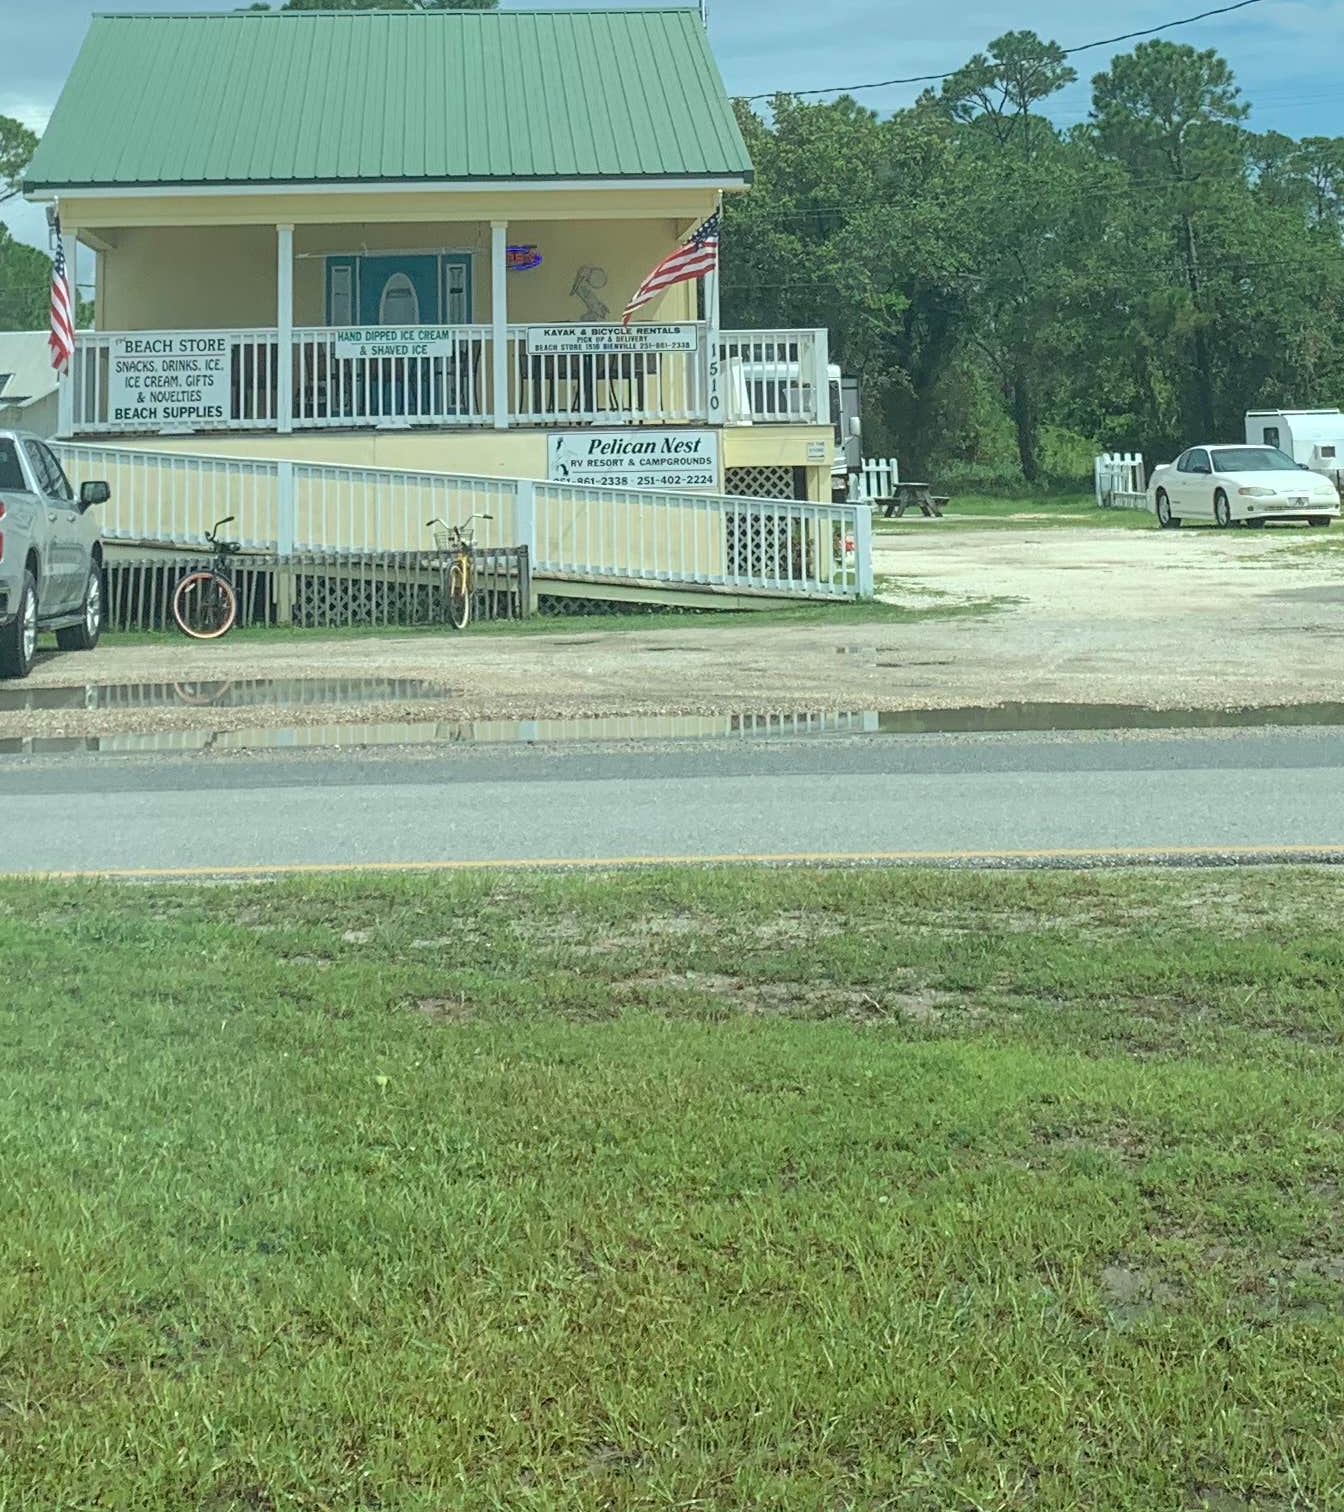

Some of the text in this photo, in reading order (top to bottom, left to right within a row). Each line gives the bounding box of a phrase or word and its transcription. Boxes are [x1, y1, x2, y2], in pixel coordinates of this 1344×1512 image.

[337, 330, 449, 342] HAND DIPPED ICE CREAM
[580, 328, 587, 336] &
[591, 327, 632, 335] BICYCLE
[125, 339, 226, 353] BEACH STORE
[359, 345, 428, 356] & SHAVED ICE
[561, 343, 583, 351] STORE
[125, 376, 141, 388] ICE
[186, 375, 214, 387] GIFTS
[136, 390, 202, 403] & NOVELTIES
[115, 406, 223, 420] BEACH SUPPLIES
[588, 437, 702, 455] Pelican Nest
[587, 459, 624, 467] RESORT
[639, 457, 712, 467] CAMPGROUNDS
[636, 475, 713, 485] 251-402-2224
